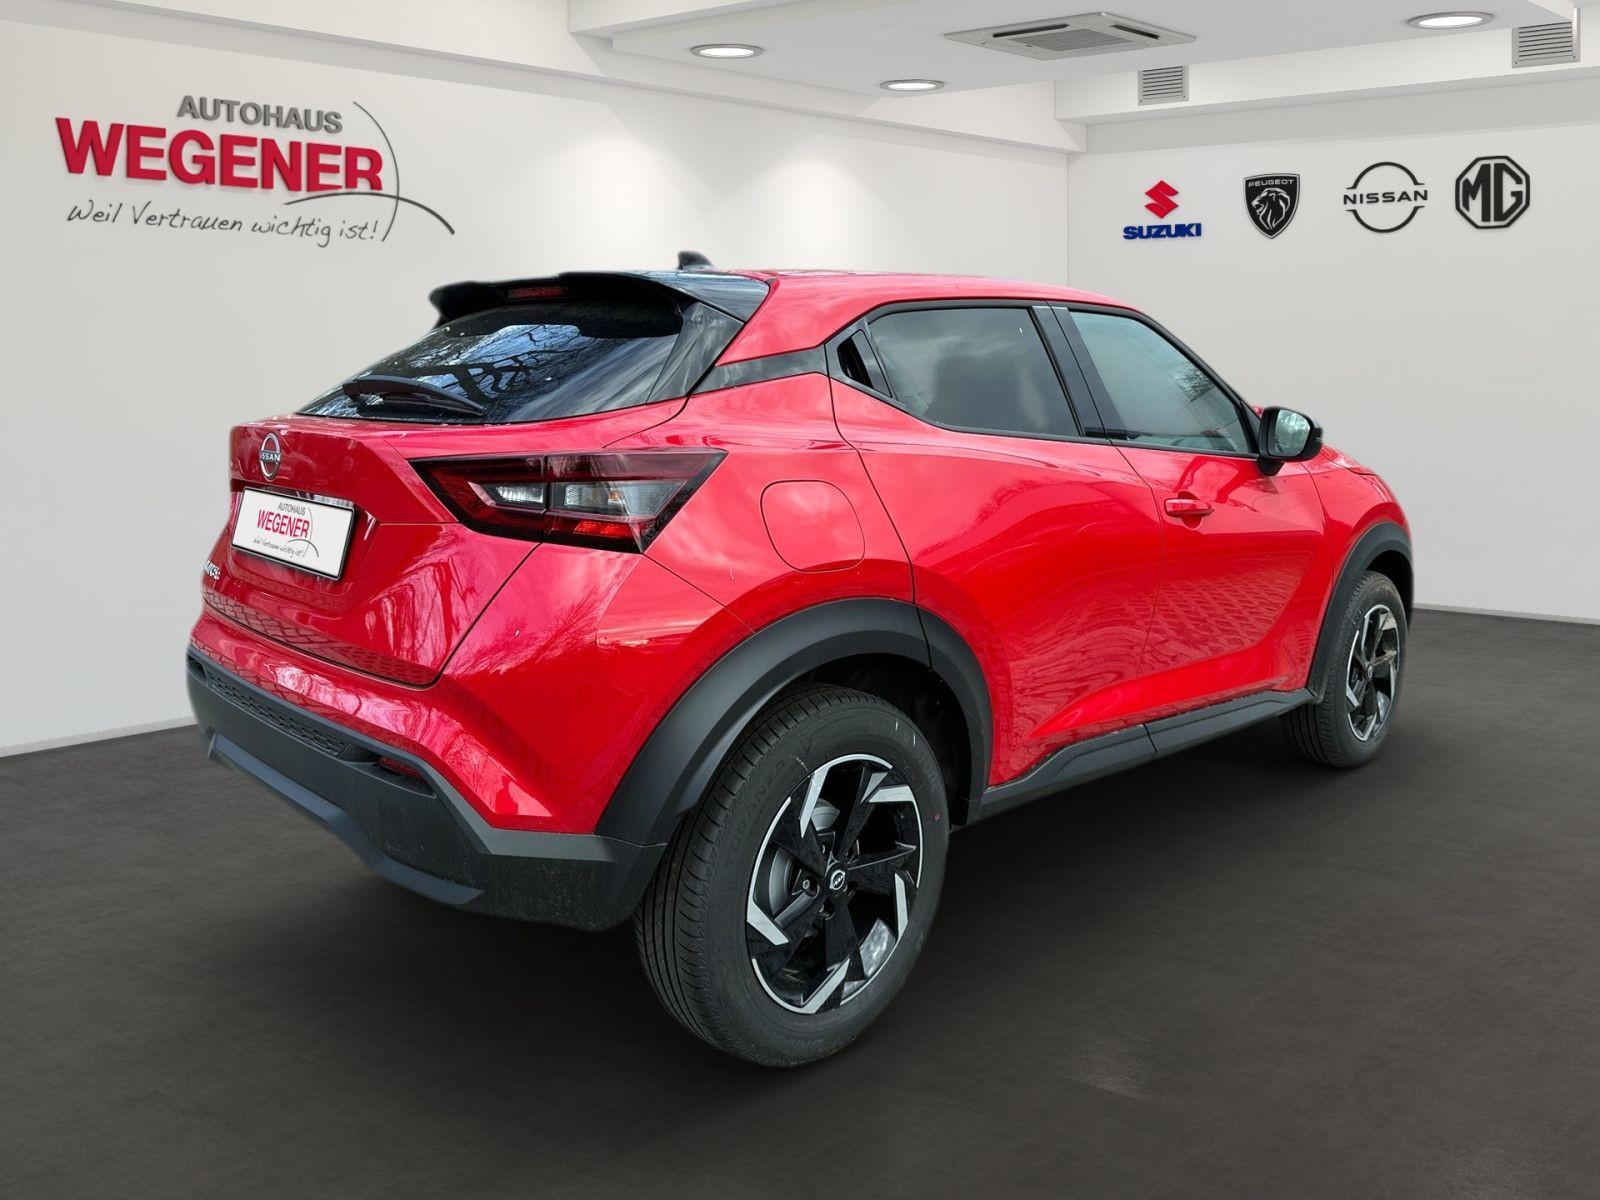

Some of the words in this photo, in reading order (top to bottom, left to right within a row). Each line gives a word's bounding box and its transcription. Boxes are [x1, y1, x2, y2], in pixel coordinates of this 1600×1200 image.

[177, 95, 343, 133] AUTOHAUS
[55, 117, 383, 193] WEGENER
[1248, 178, 1295, 188] PEUGEOT
[1343, 189, 1429, 206] NISSAN
[1462, 162, 1524, 223] MG
[67, 200, 122, 223] Weil
[132, 200, 242, 232] Vertrauen
[251, 213, 331, 248] wichtig
[339, 221, 379, 241] ist!
[1123, 223, 1202, 240] SUZUKI
[257, 509, 310, 538] WEGENER
[278, 503, 306, 516] AUTOHAUS
